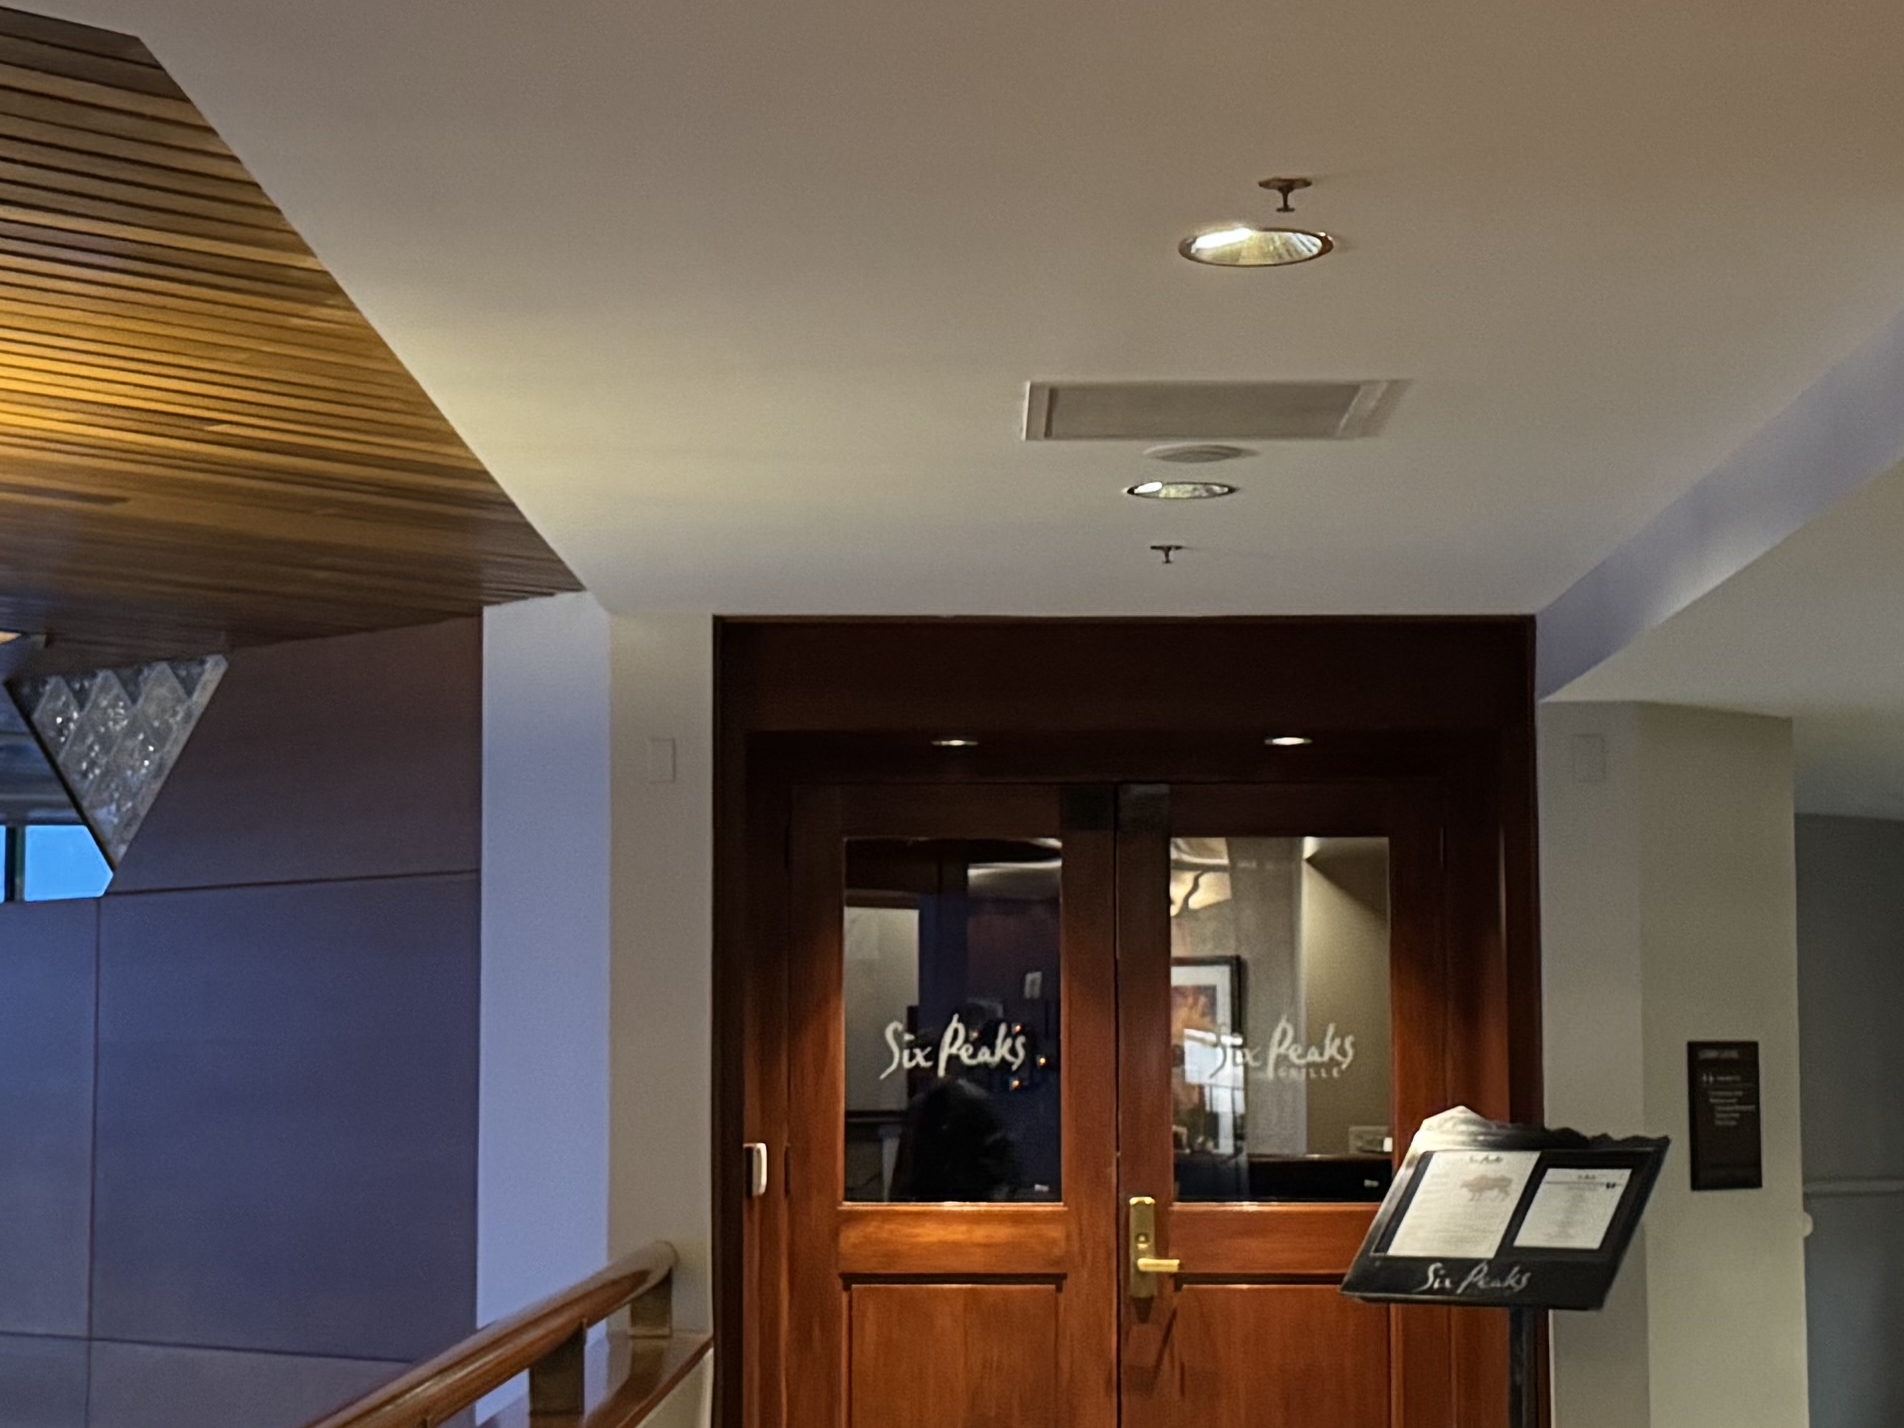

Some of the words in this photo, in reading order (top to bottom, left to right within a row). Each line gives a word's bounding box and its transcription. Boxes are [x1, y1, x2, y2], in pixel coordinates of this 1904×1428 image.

[879, 1021, 933, 1080] Six
[938, 1013, 1027, 1078] Peaks
[1267, 1013, 1355, 1080] Peaks
